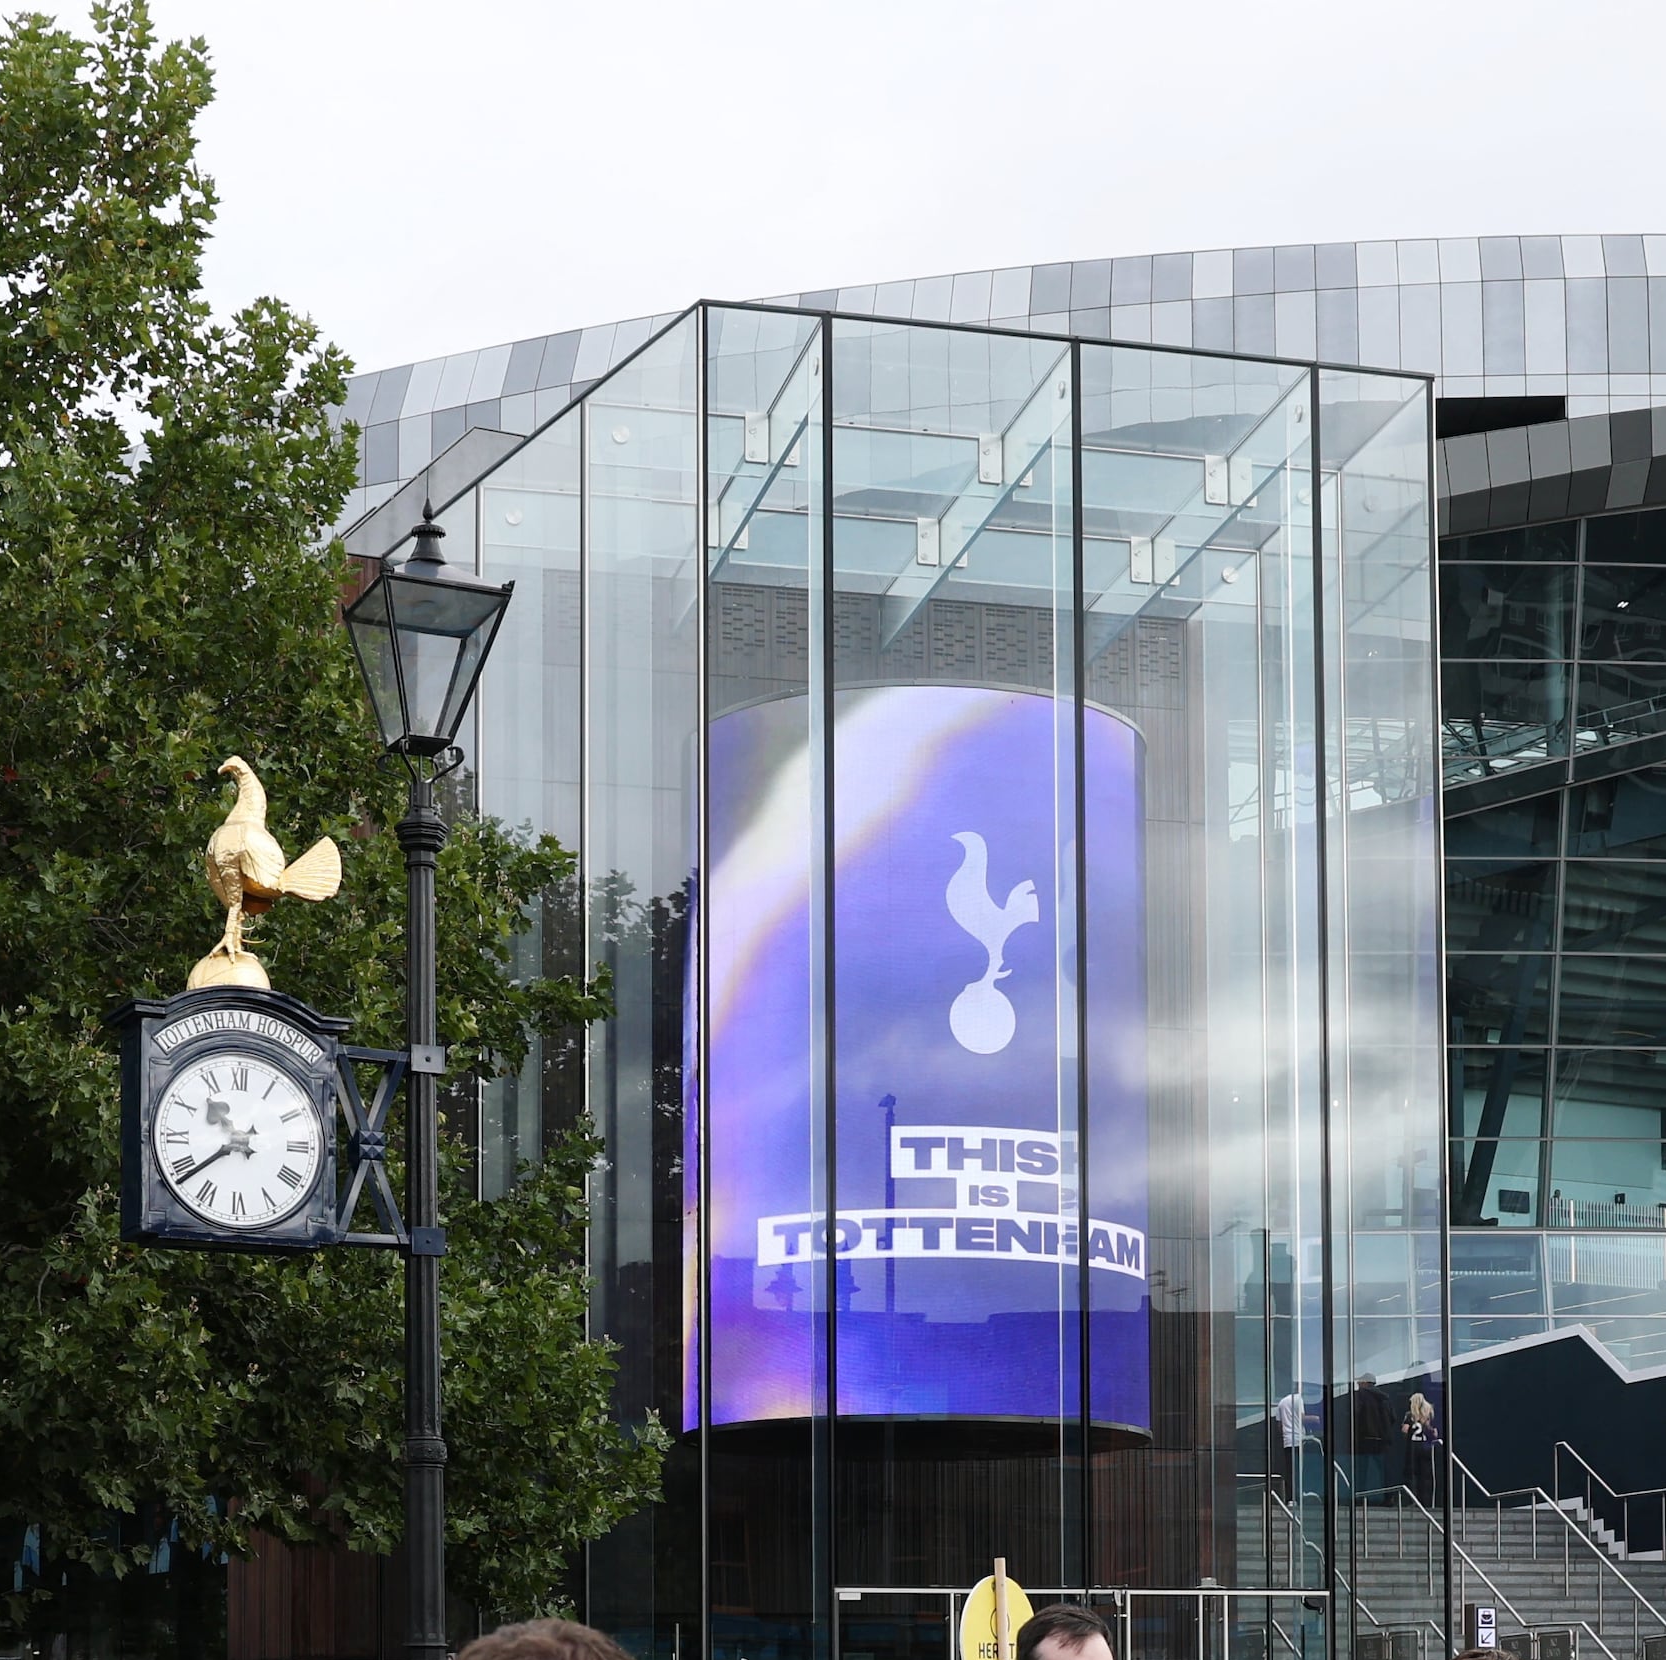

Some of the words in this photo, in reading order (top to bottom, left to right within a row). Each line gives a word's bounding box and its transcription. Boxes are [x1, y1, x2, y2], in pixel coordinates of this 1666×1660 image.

[156, 1010, 252, 1050] TOTTENHAM
[257, 1015, 322, 1063] HOTSPUR
[900, 1137, 1059, 1176] THIS
[969, 1184, 1010, 1208] IS
[773, 1216, 1141, 1270] TOTTENHAM
